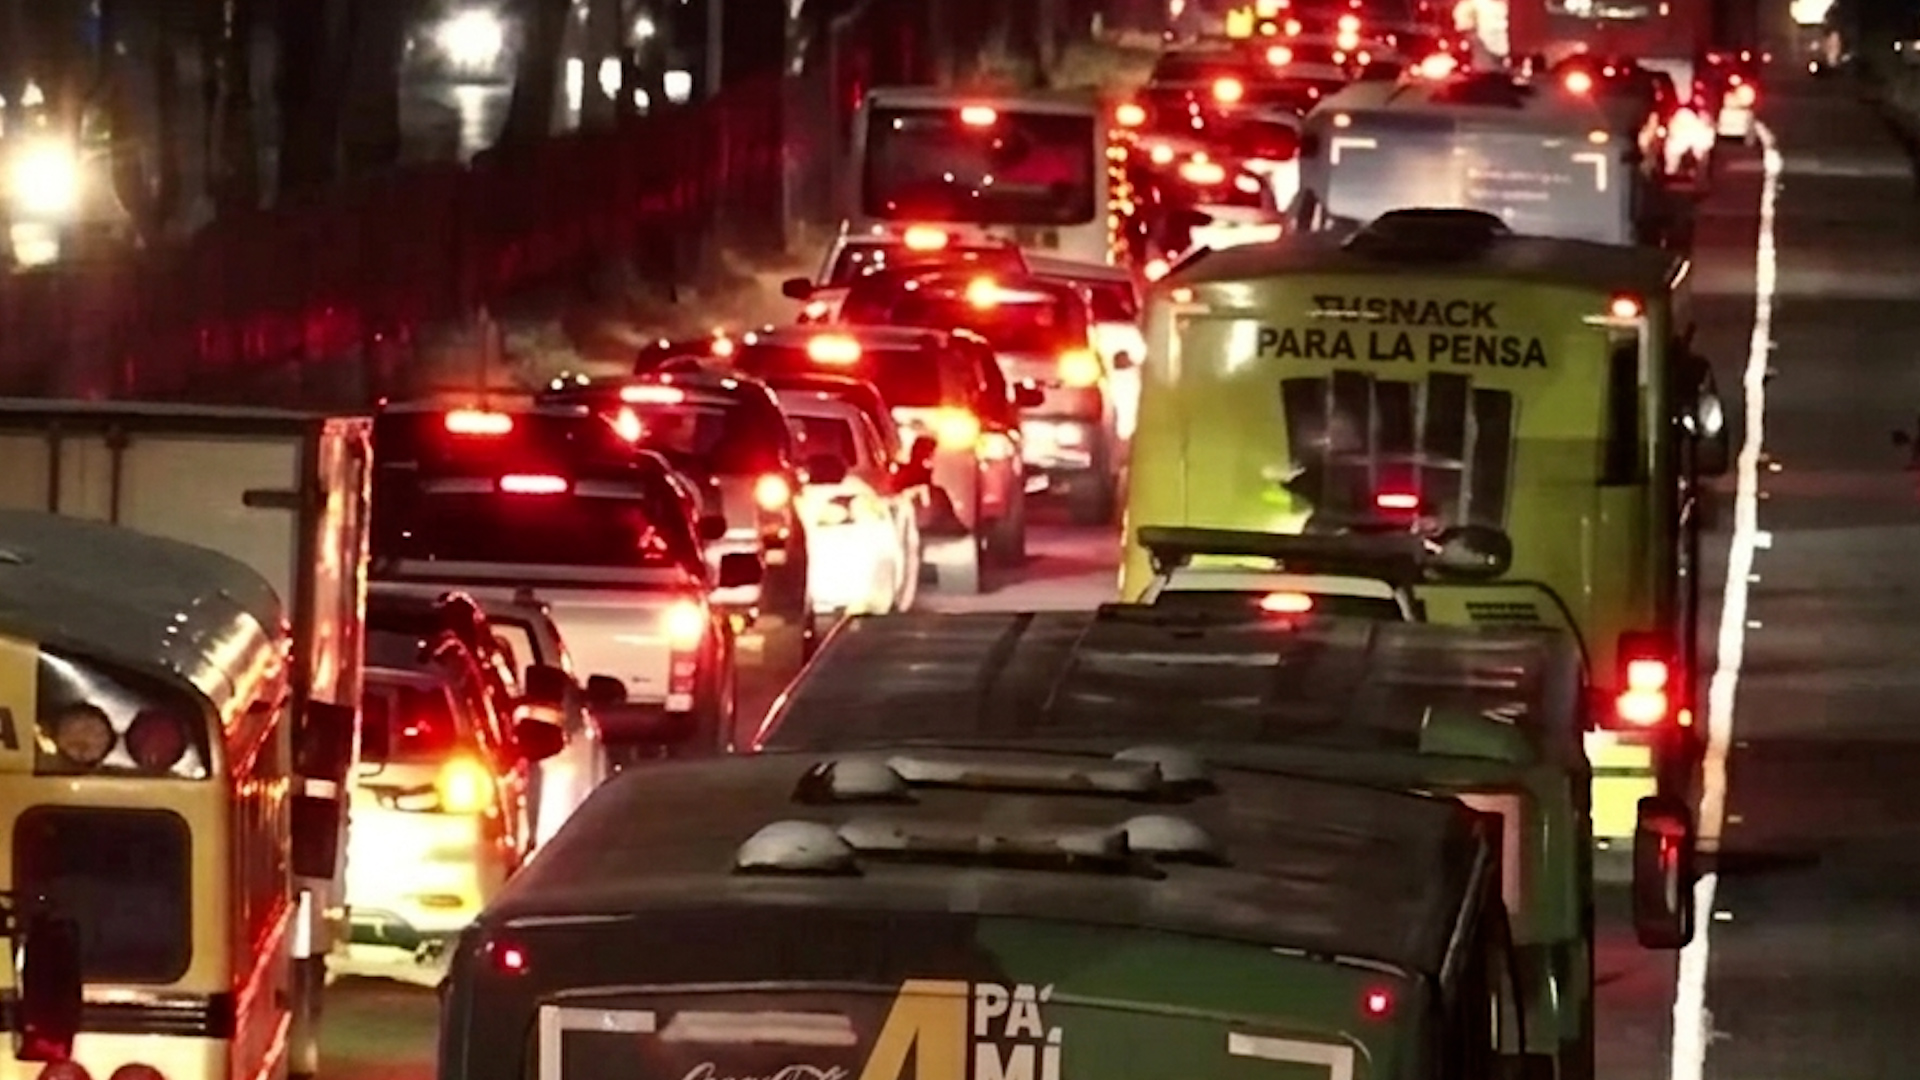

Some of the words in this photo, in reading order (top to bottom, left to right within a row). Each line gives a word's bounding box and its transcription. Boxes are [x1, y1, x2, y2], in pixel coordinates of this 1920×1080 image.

[1256, 327, 1356, 360] PARA
[1368, 330, 1416, 362] LA
[1427, 333, 1548, 369] PENSA
